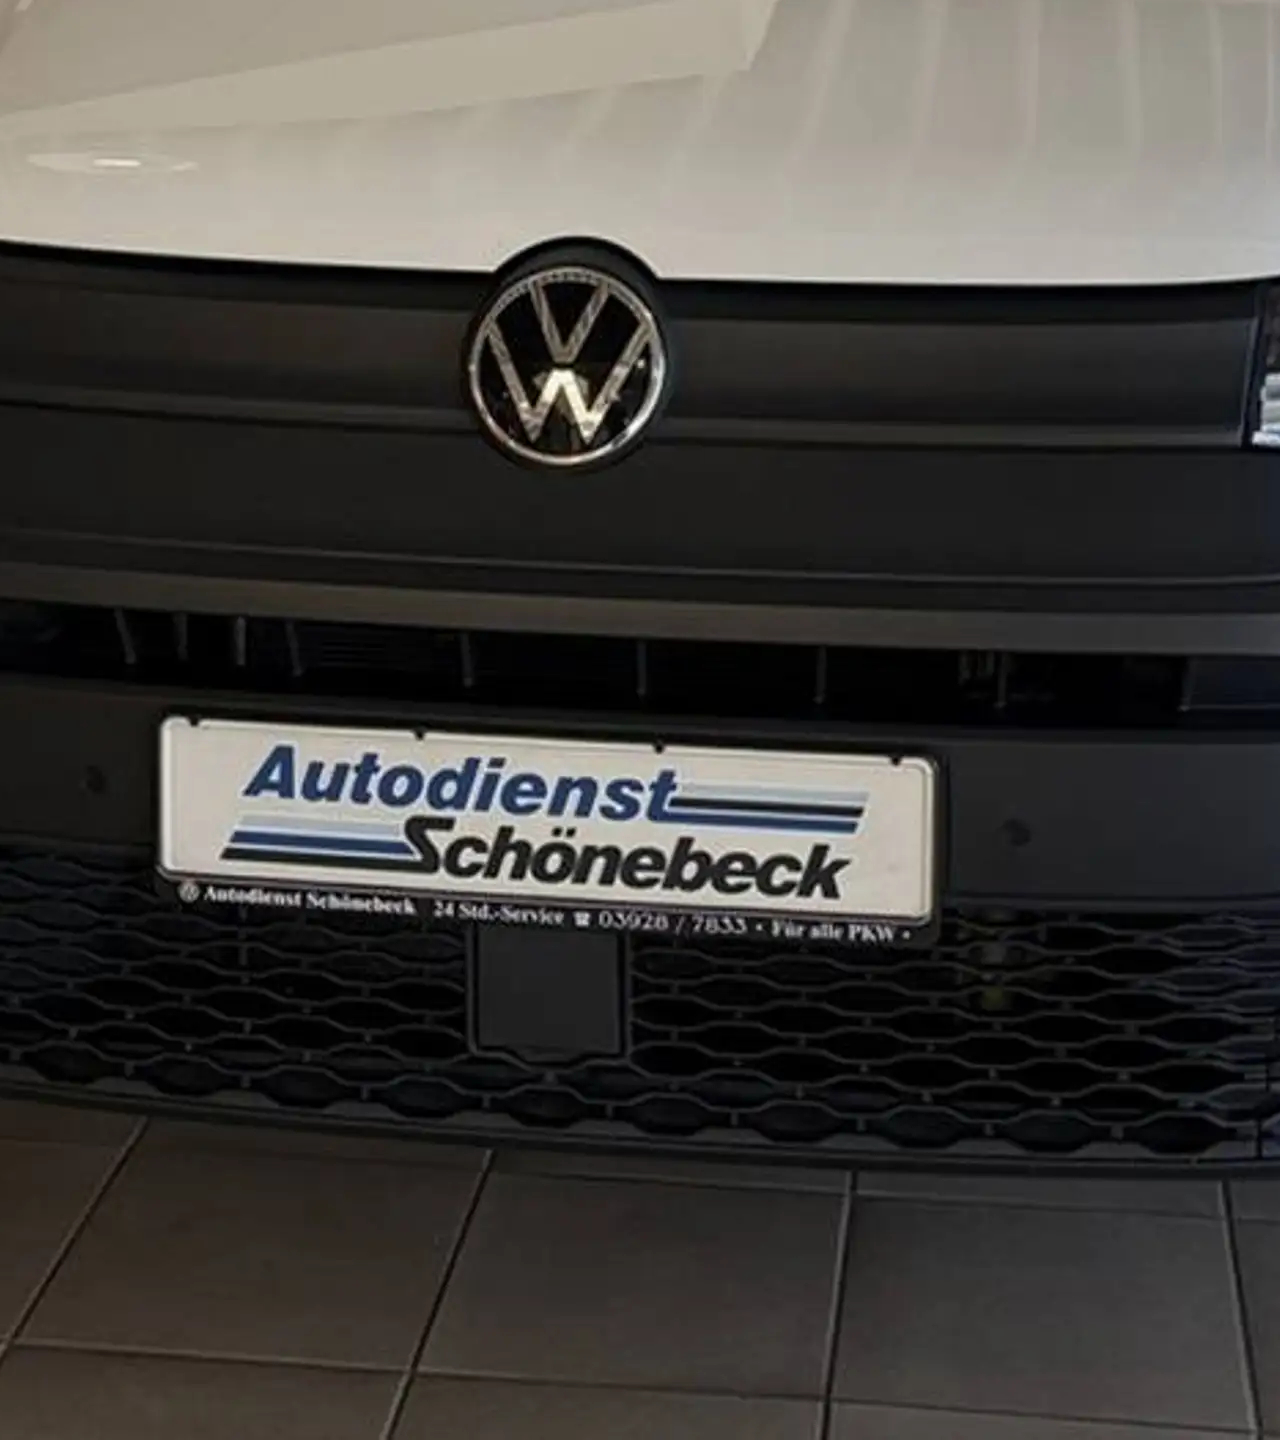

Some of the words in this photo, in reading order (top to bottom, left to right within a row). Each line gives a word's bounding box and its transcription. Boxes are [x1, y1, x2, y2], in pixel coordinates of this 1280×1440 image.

[243, 744, 677, 822] Autodienst
[404, 815, 850, 898] Schönebeck
[203, 885, 302, 908] Autodienst
[306, 891, 417, 916] Schönebeck
[848, 923, 895, 944] PKW
